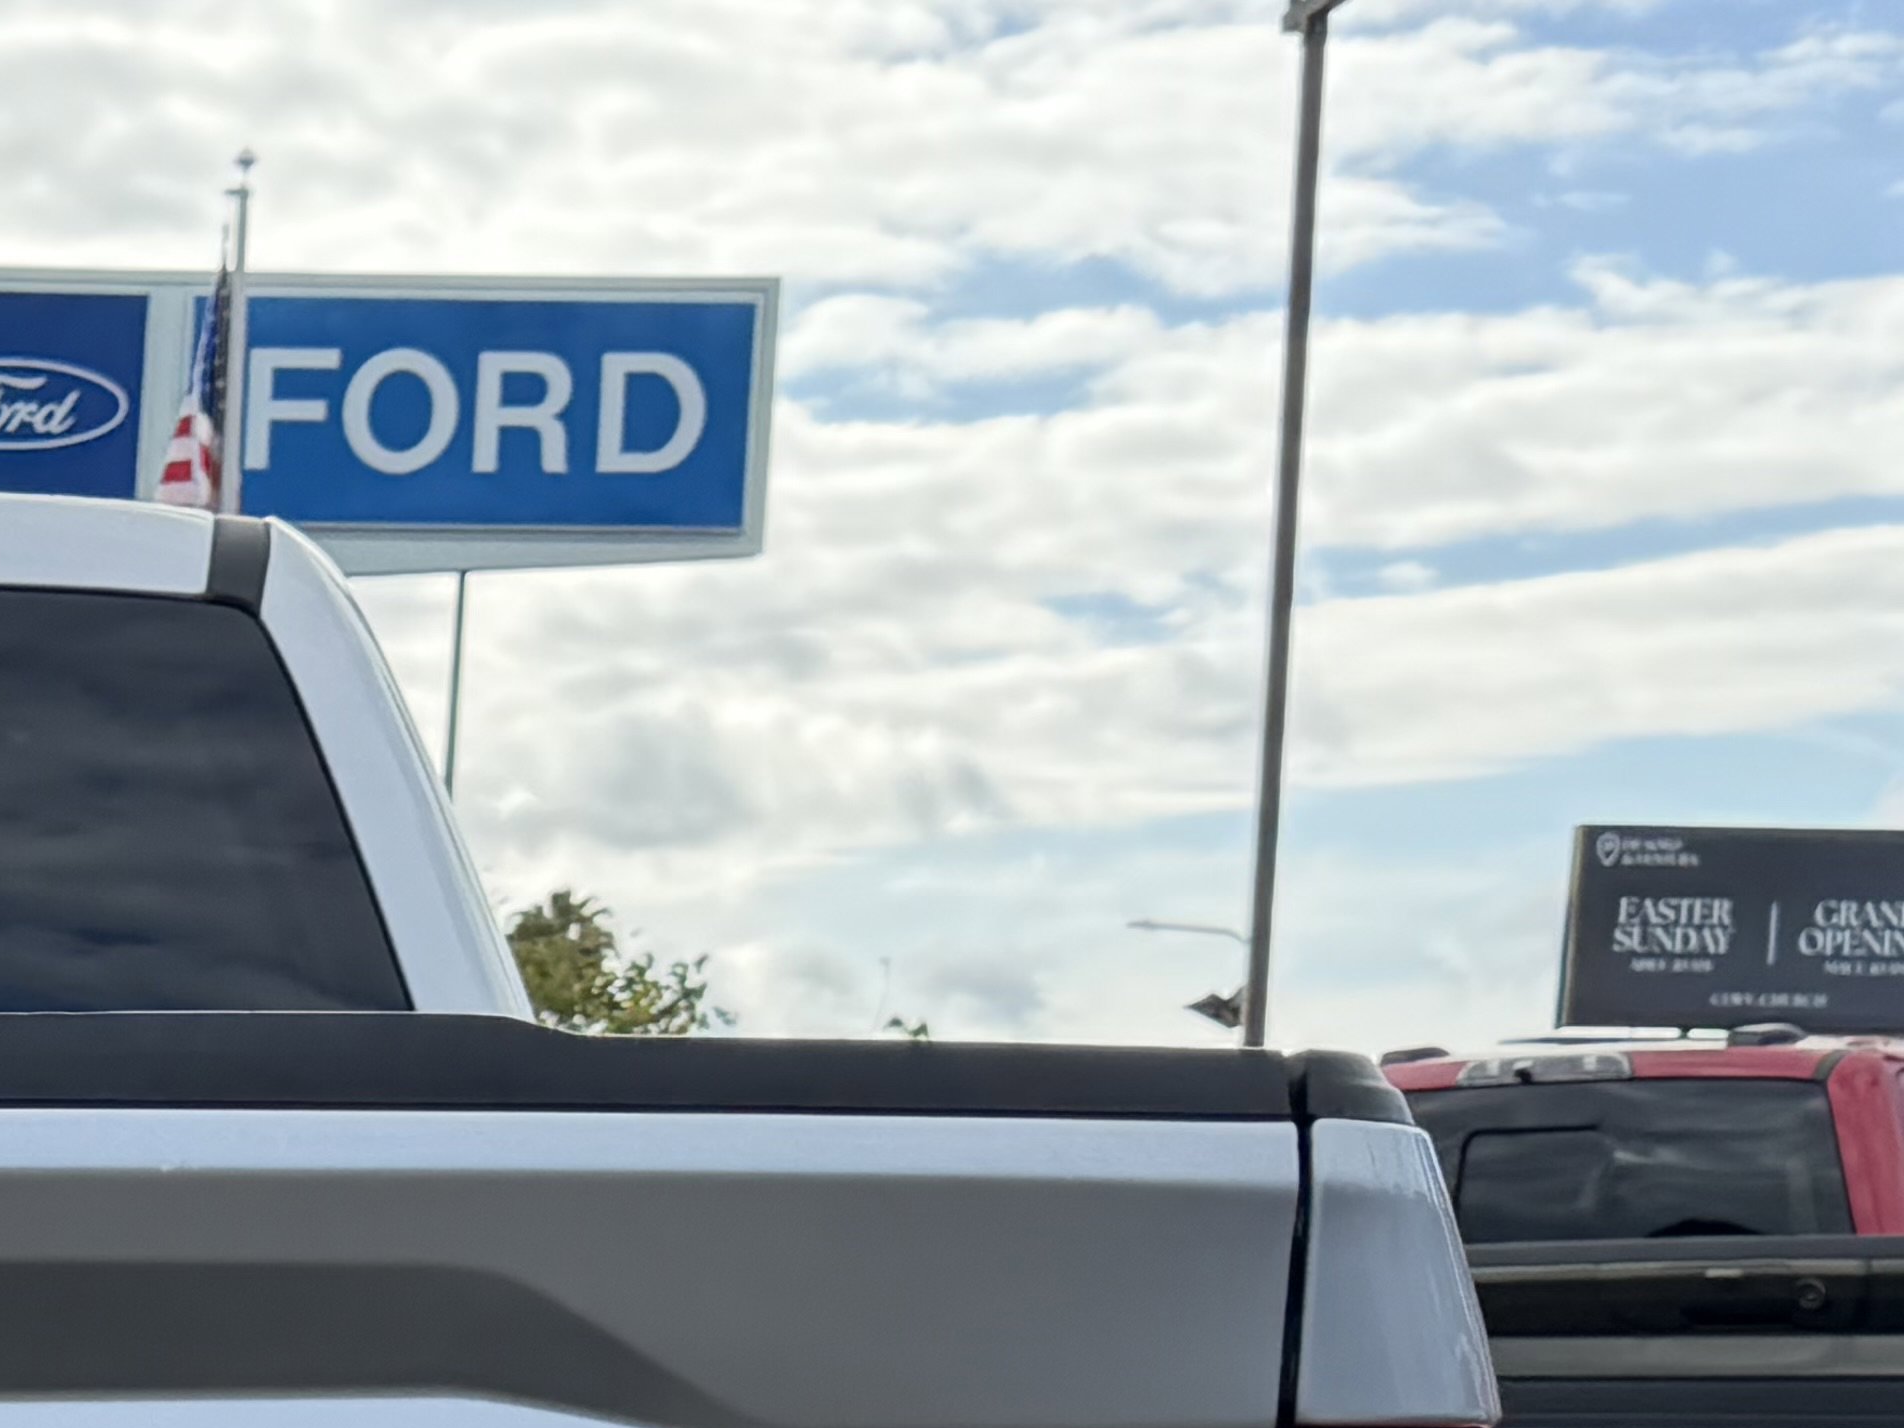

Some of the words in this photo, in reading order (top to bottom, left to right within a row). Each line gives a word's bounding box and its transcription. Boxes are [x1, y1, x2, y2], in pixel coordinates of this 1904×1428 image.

[243, 347, 708, 475] FORD
[1618, 896, 1732, 925] EASTER
[1813, 899, 1904, 928] GRAN
[1612, 926, 1734, 955] SUNDAY
